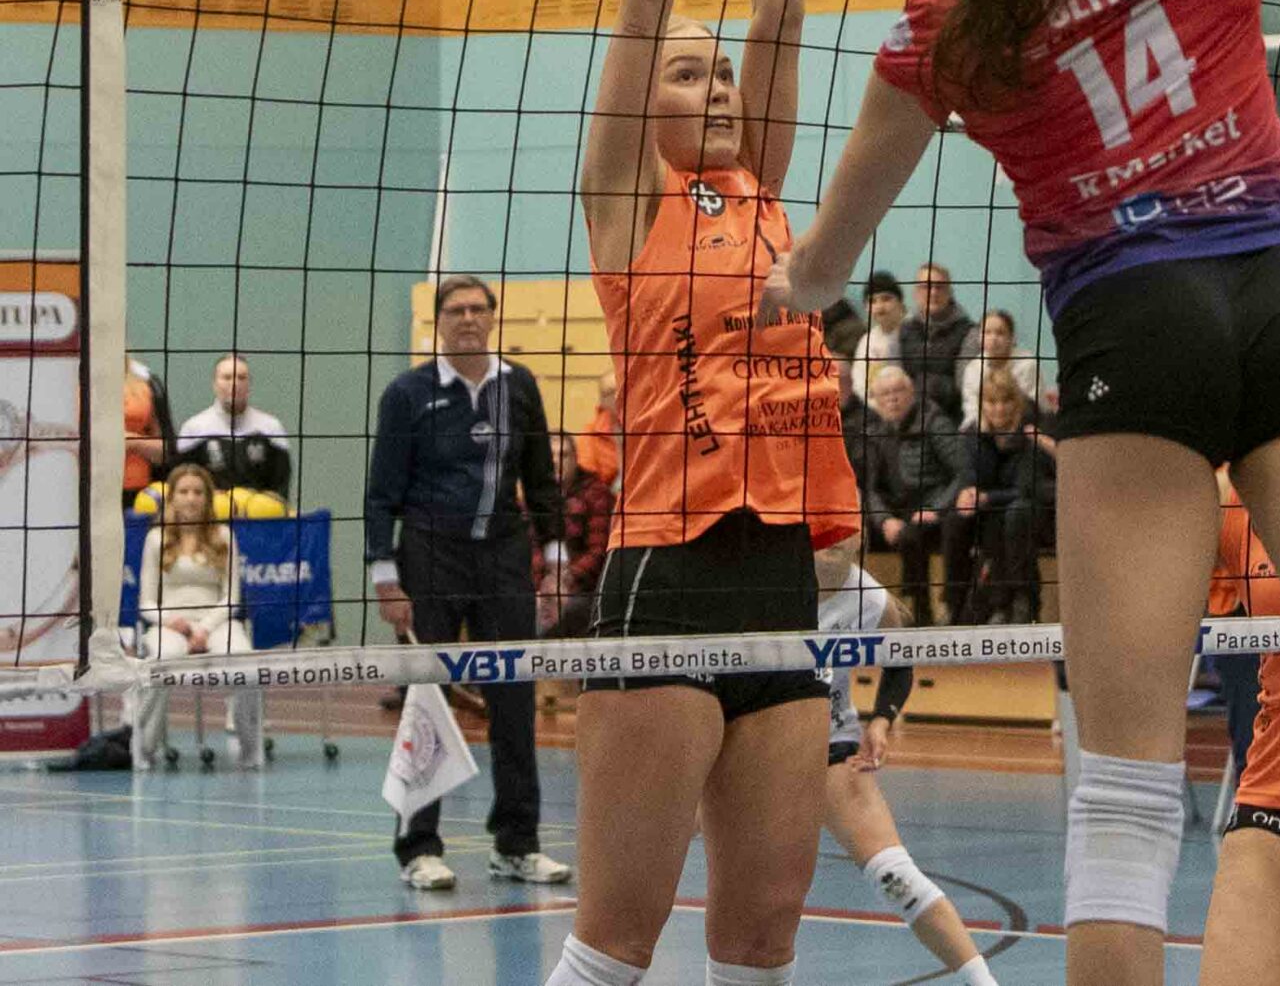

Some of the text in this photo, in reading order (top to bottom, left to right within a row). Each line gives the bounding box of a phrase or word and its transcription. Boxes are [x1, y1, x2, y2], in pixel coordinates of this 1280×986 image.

[437, 647, 749, 683] YBT Parasta Betonista.
[803, 635, 1063, 669] YBT Parasta Betonis
[257, 662, 386, 687] Betonista.
